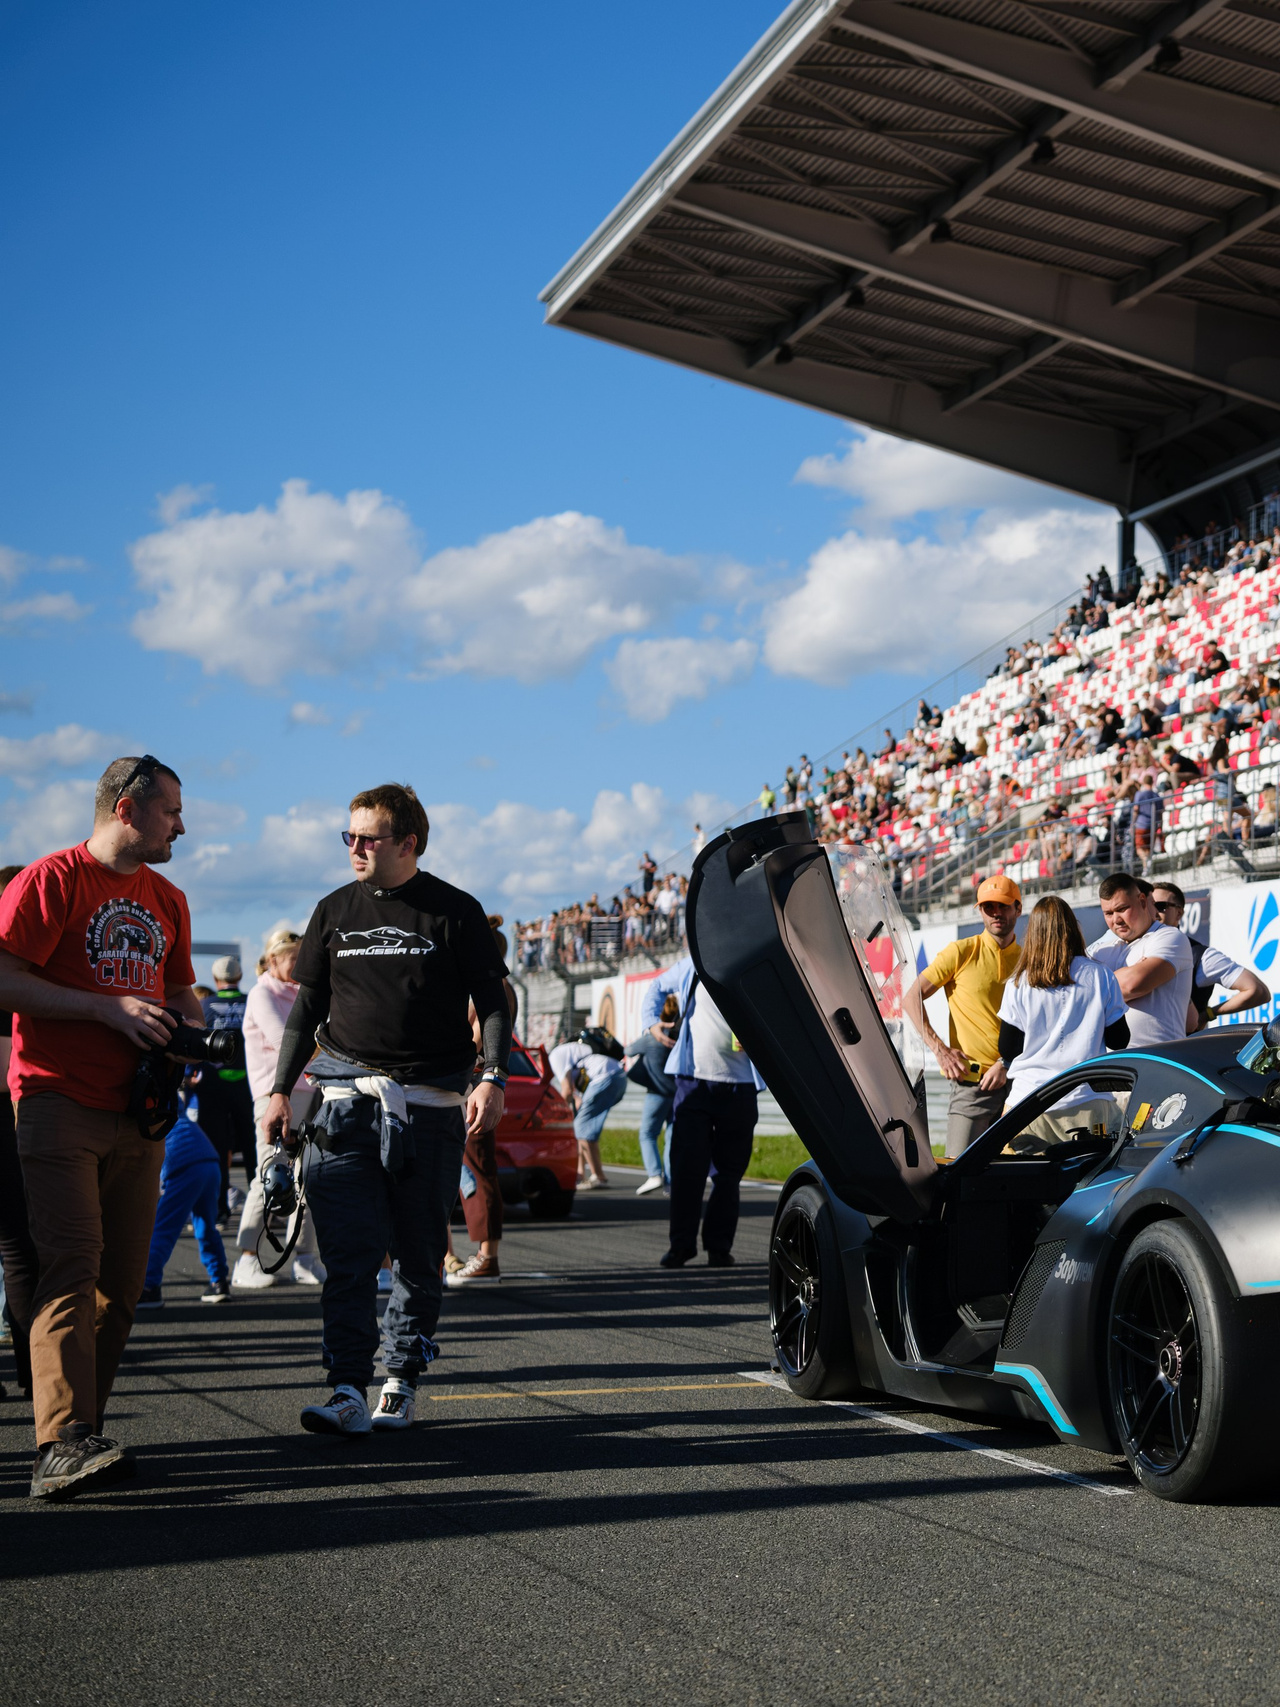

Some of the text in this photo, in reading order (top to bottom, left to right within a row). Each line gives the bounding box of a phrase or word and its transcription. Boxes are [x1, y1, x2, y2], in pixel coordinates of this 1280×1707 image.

[97, 950, 129, 959] SARATOV
[337, 947, 407, 958] MARUSSIA
[95, 958, 158, 992] CLUB
